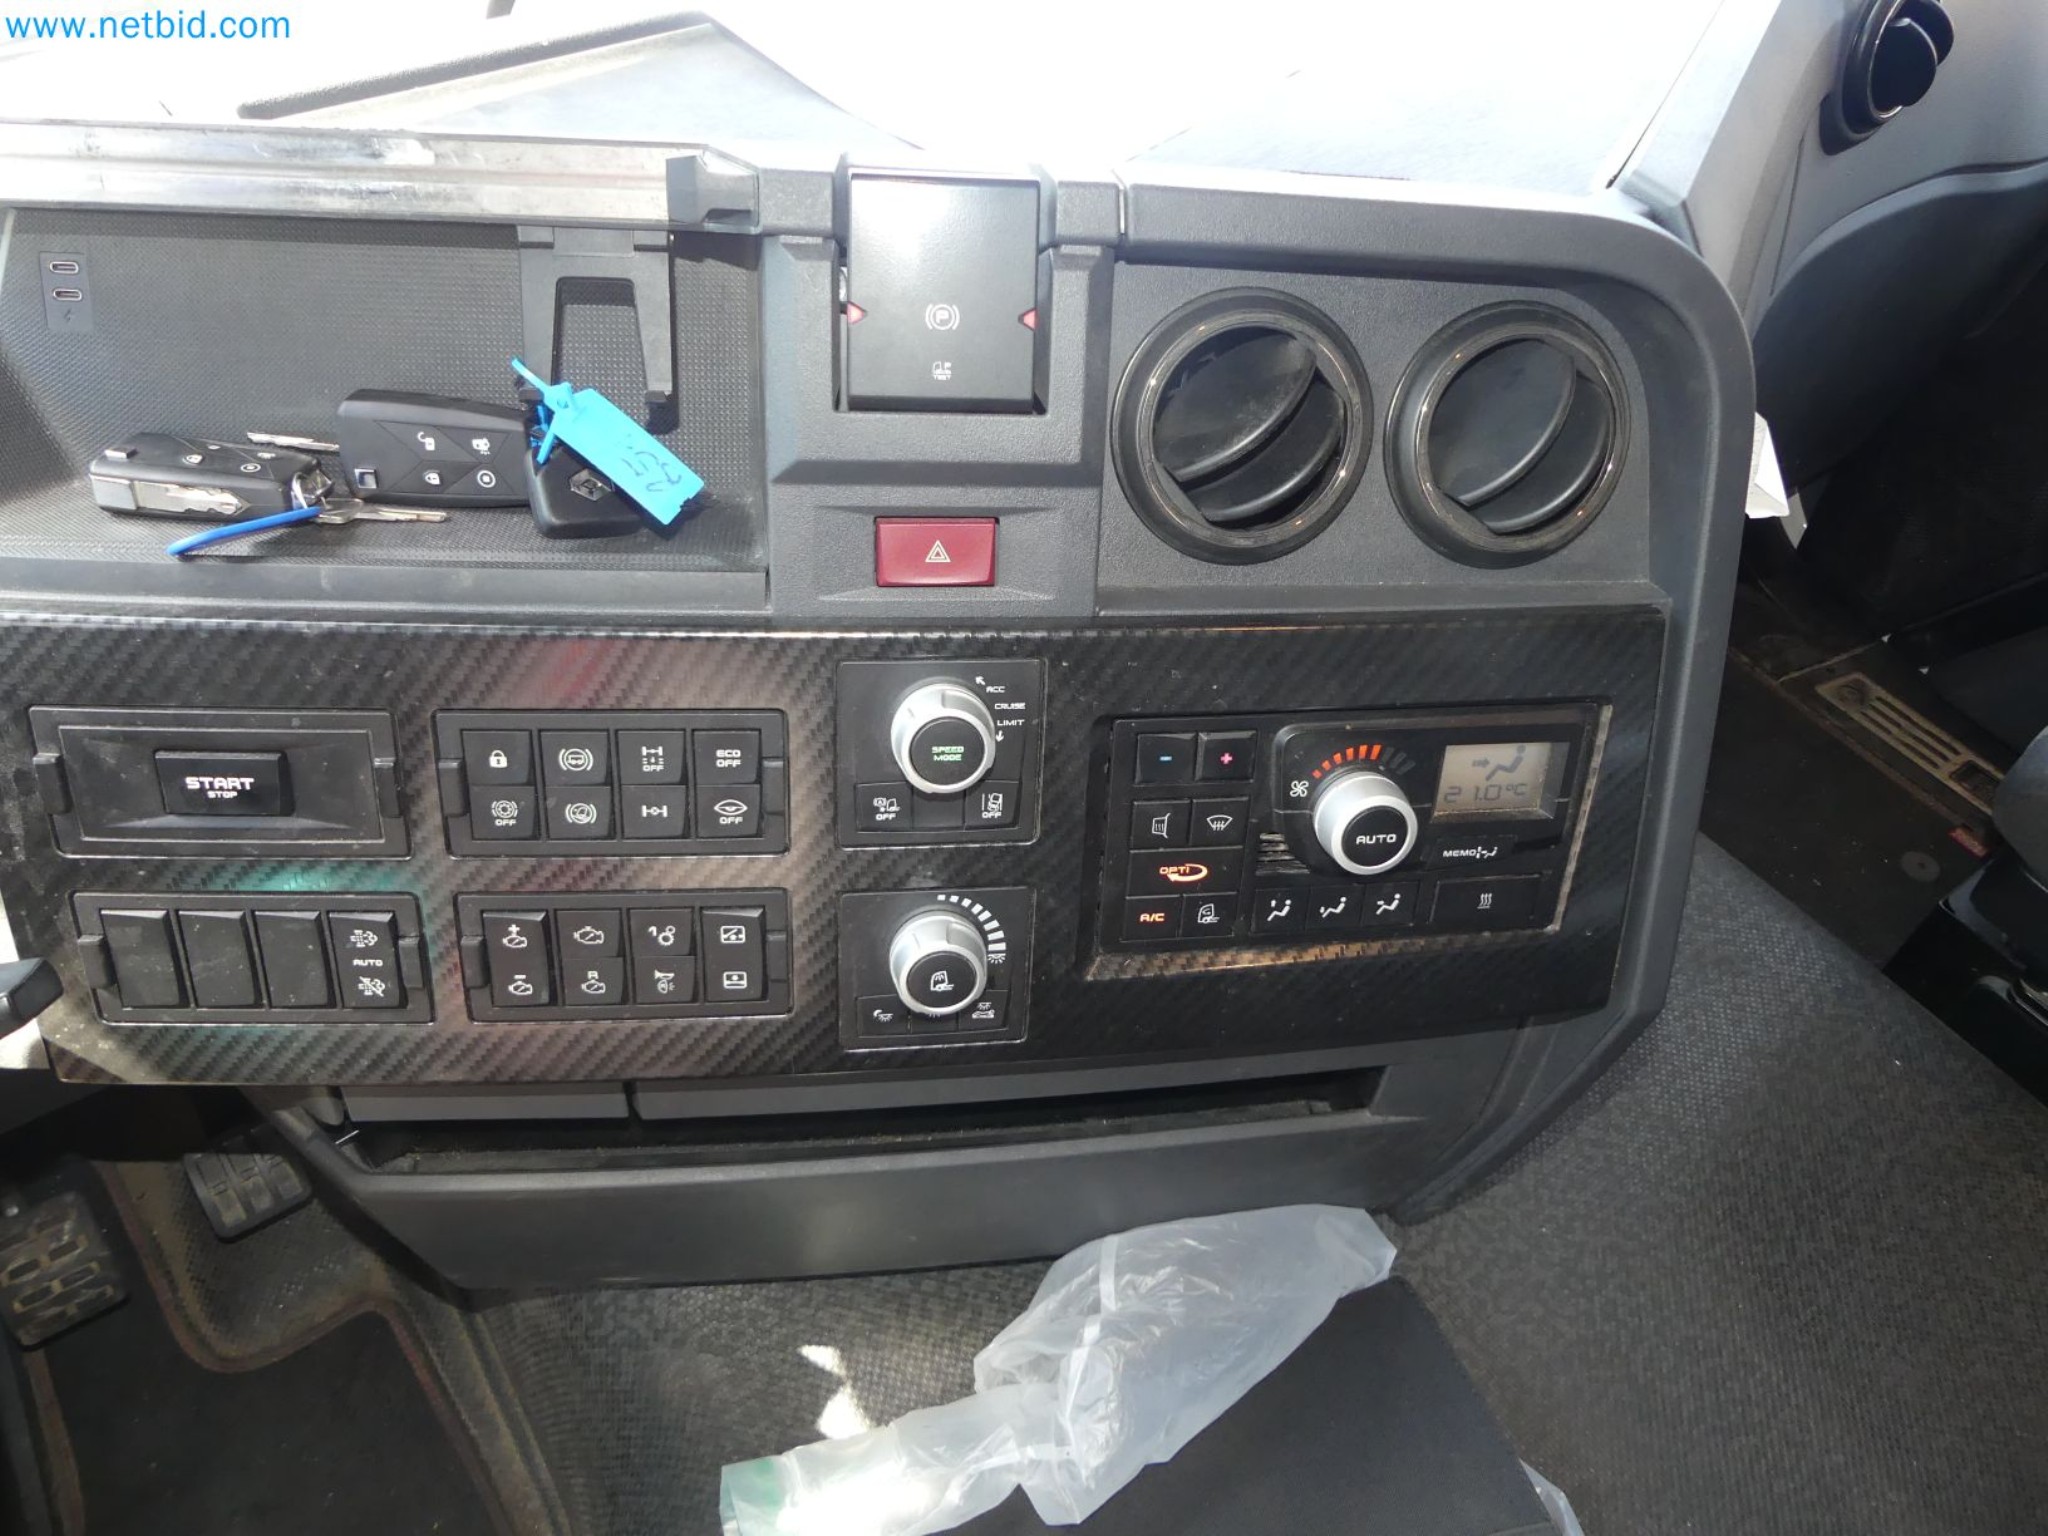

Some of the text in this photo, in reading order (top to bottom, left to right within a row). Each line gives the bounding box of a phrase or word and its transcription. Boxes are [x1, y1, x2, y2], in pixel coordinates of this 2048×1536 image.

[986, 685, 1006, 693] ACC
[994, 702, 1026, 710] CRUISE
[715, 749, 741, 758] ECO
[931, 746, 965, 754] SPEED
[716, 758, 741, 767] OFF
[933, 754, 962, 762] MODE
[642, 764, 664, 772] OFF
[185, 776, 254, 790] START
[207, 790, 238, 799] STOP
[719, 815, 743, 824] OFF
[981, 811, 1002, 819] OFF
[494, 818, 516, 826] OFF
[1355, 833, 1398, 845] AUTO
[1442, 849, 1476, 858] MEMO
[1159, 866, 1190, 875] OPTI
[1140, 912, 1166, 923] A/C
[353, 958, 383, 967] AUTO
